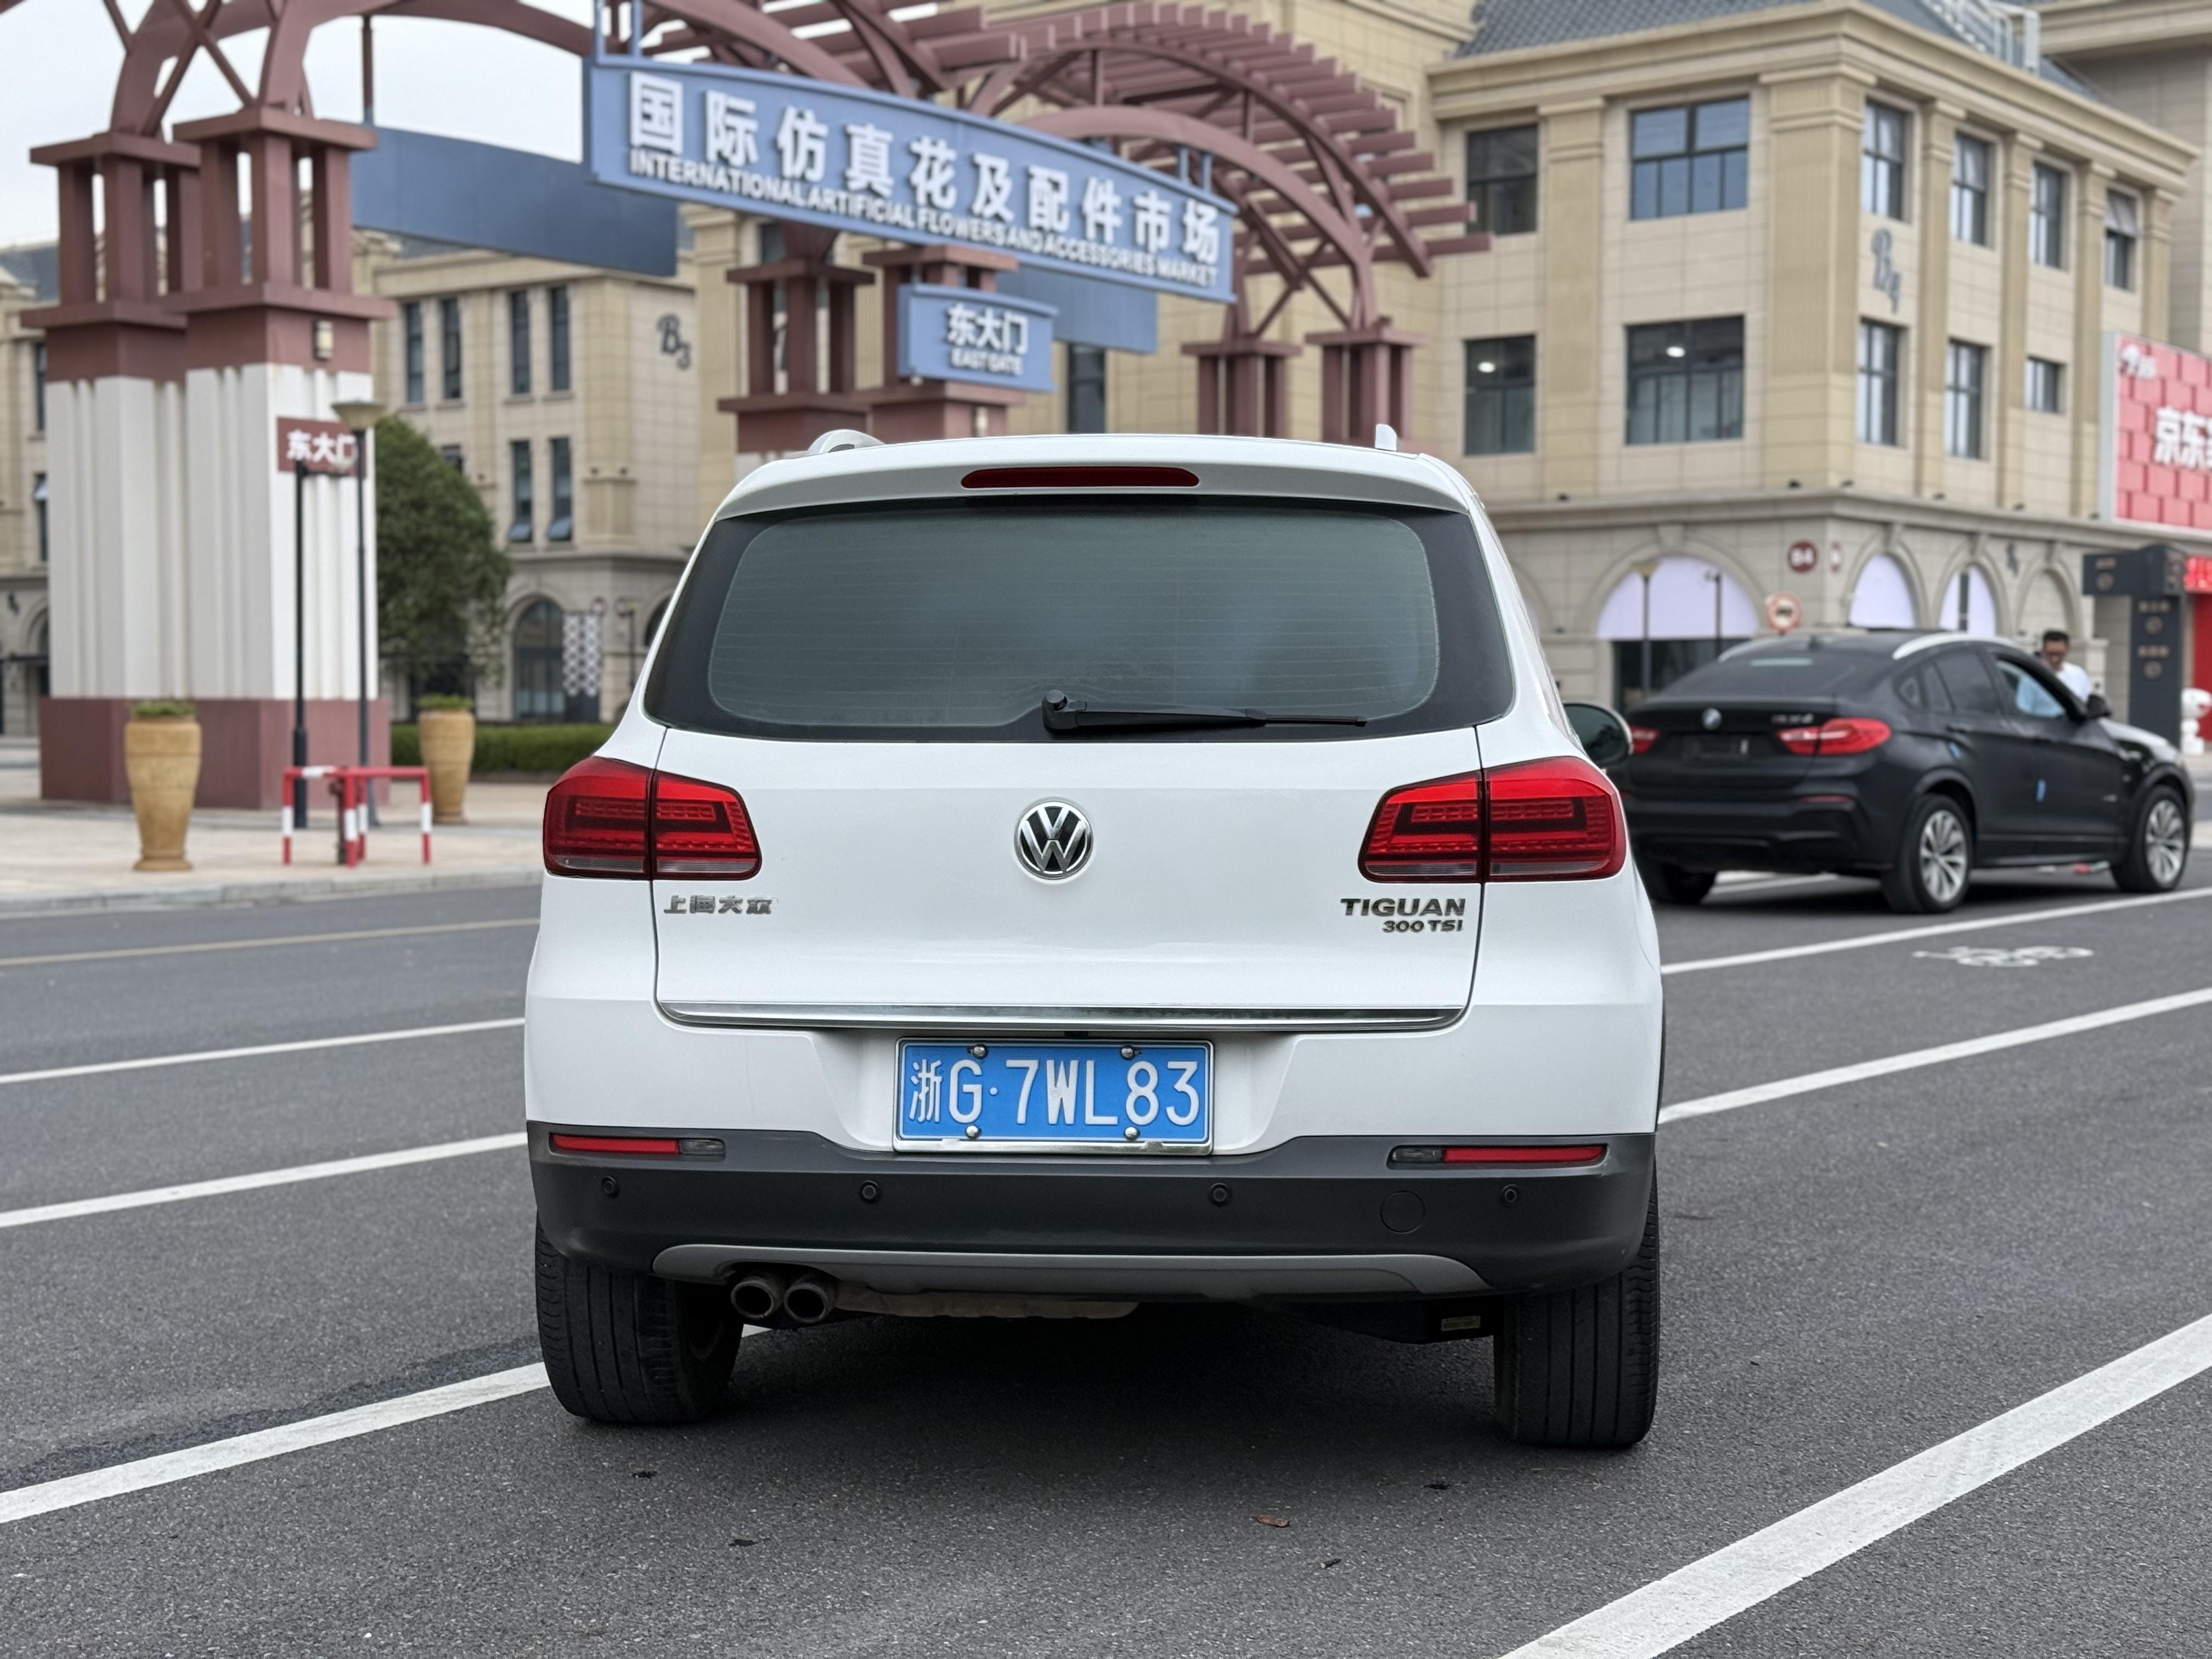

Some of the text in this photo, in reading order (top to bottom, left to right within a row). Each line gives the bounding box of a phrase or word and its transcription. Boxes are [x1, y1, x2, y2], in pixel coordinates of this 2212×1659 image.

[629, 71, 1220, 264] 国际仿真花及配件市场
[630, 148, 804, 206] INTERNATIONAL
[808, 187, 915, 228] ARTIFICIAL
[917, 208, 1005, 247] FLOWERS
[1006, 227, 1042, 253] AND
[1154, 260, 1217, 287] MARKET
[947, 302, 1028, 355] 东大门
[663, 895, 772, 915] 上海大众
[1340, 898, 1465, 917] TIGUAN
[1382, 919, 1464, 933] 300 TSI
